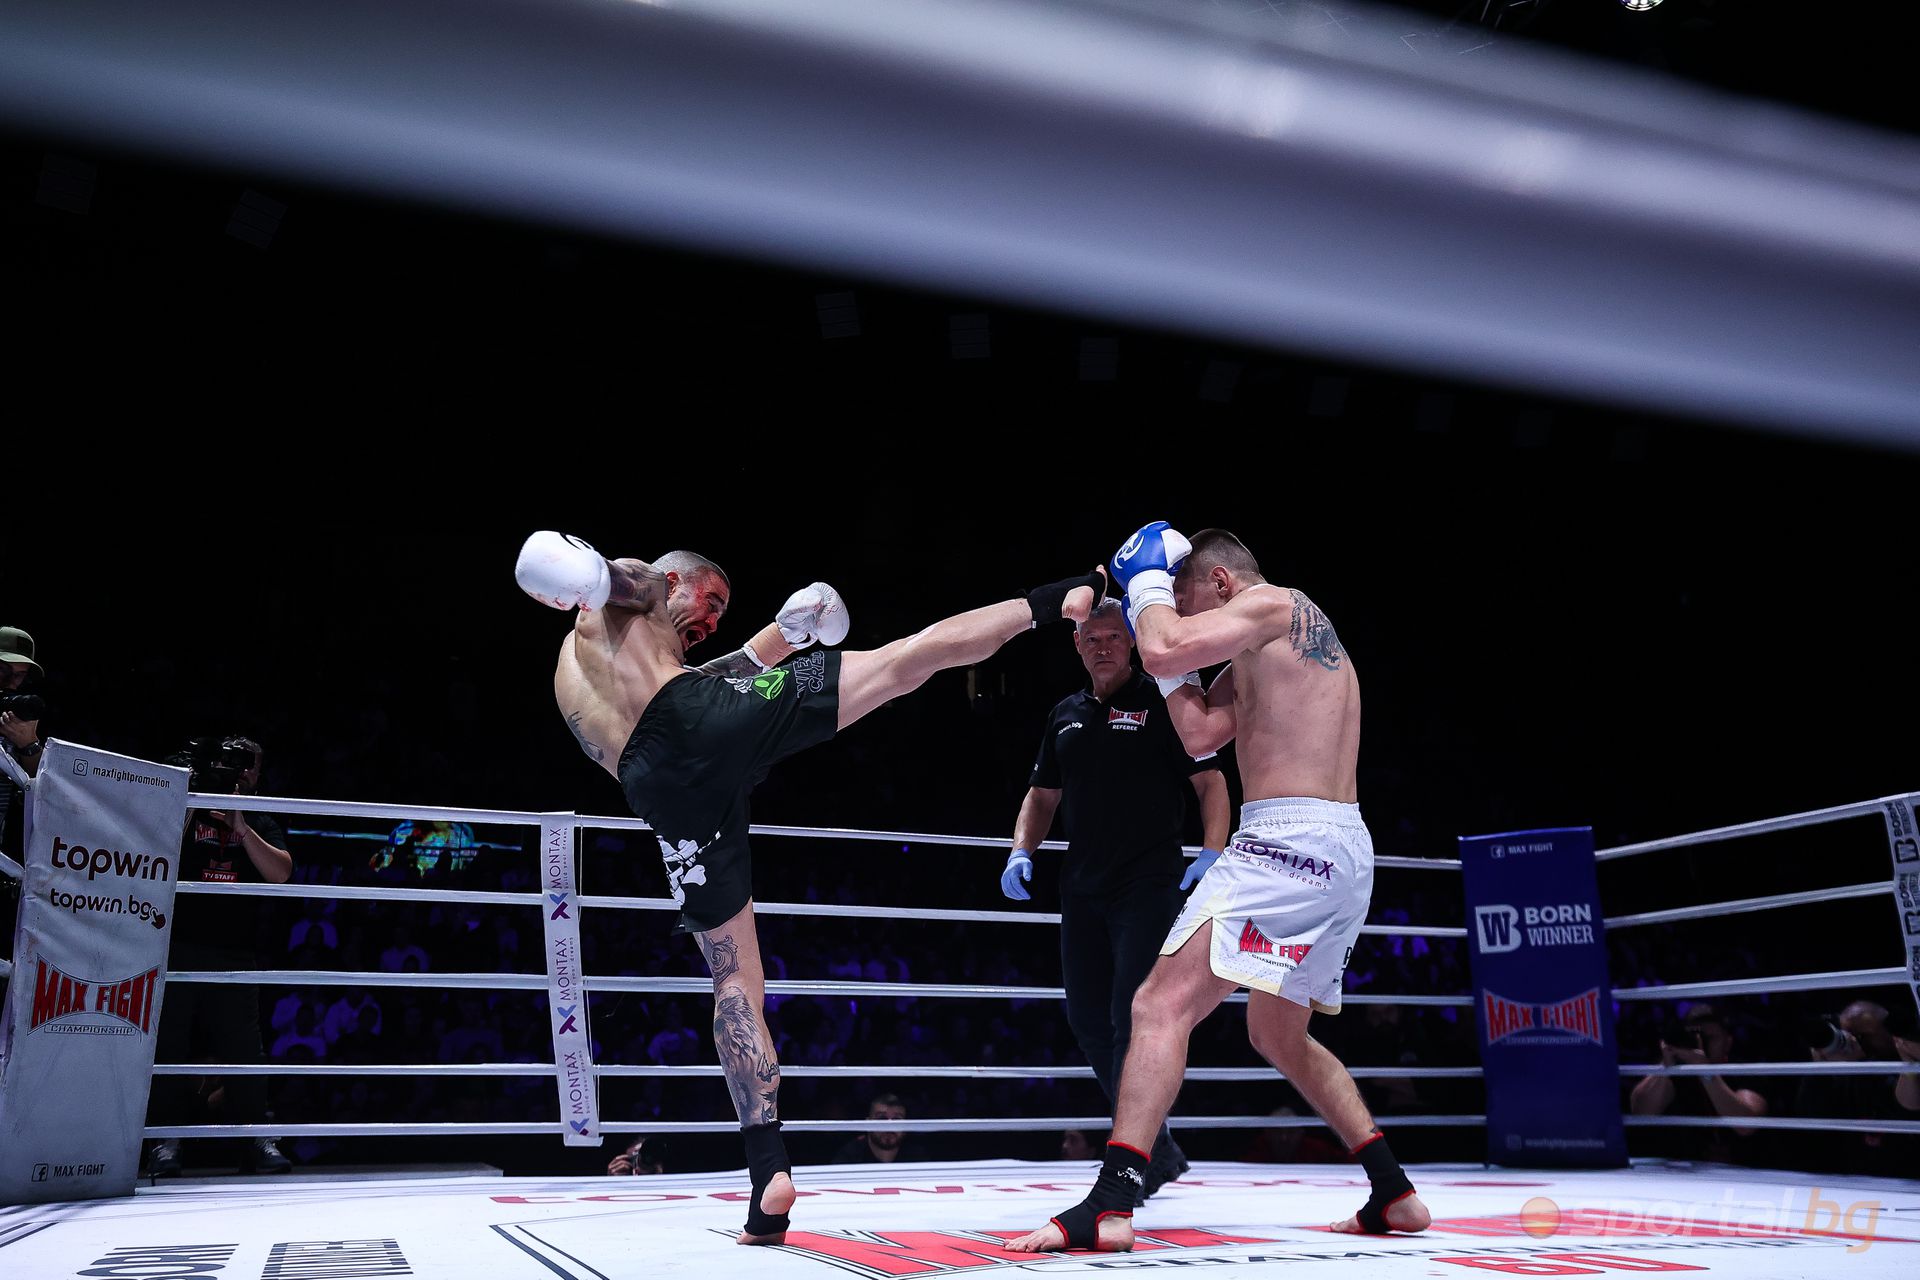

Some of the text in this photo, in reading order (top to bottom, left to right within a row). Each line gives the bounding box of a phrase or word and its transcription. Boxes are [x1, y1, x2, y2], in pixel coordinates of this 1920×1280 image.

[92, 765, 170, 789] maxfightpromotion
[51, 836, 169, 882] topwin
[549, 828, 562, 889] MONTAX
[1508, 843, 1553, 854] MAX FIGHT
[1257, 860, 1327, 890] your dreams
[50, 888, 154, 921] topwin.bg
[1524, 904, 1592, 924] BORN
[1240, 919, 1273, 954] MAX
[1526, 925, 1594, 947] WINNER
[555, 937, 571, 1001] MONTAX
[31, 958, 159, 1034] MAX FIGHT
[50, 1023, 134, 1035] CHAMPIONSHIP
[1485, 990, 1600, 1041] MAX FIGHT
[564, 1051, 583, 1115] MONTAX
[53, 1163, 104, 1177] MAX FIGHT
[1430, 1253, 1710, 1276] 60
